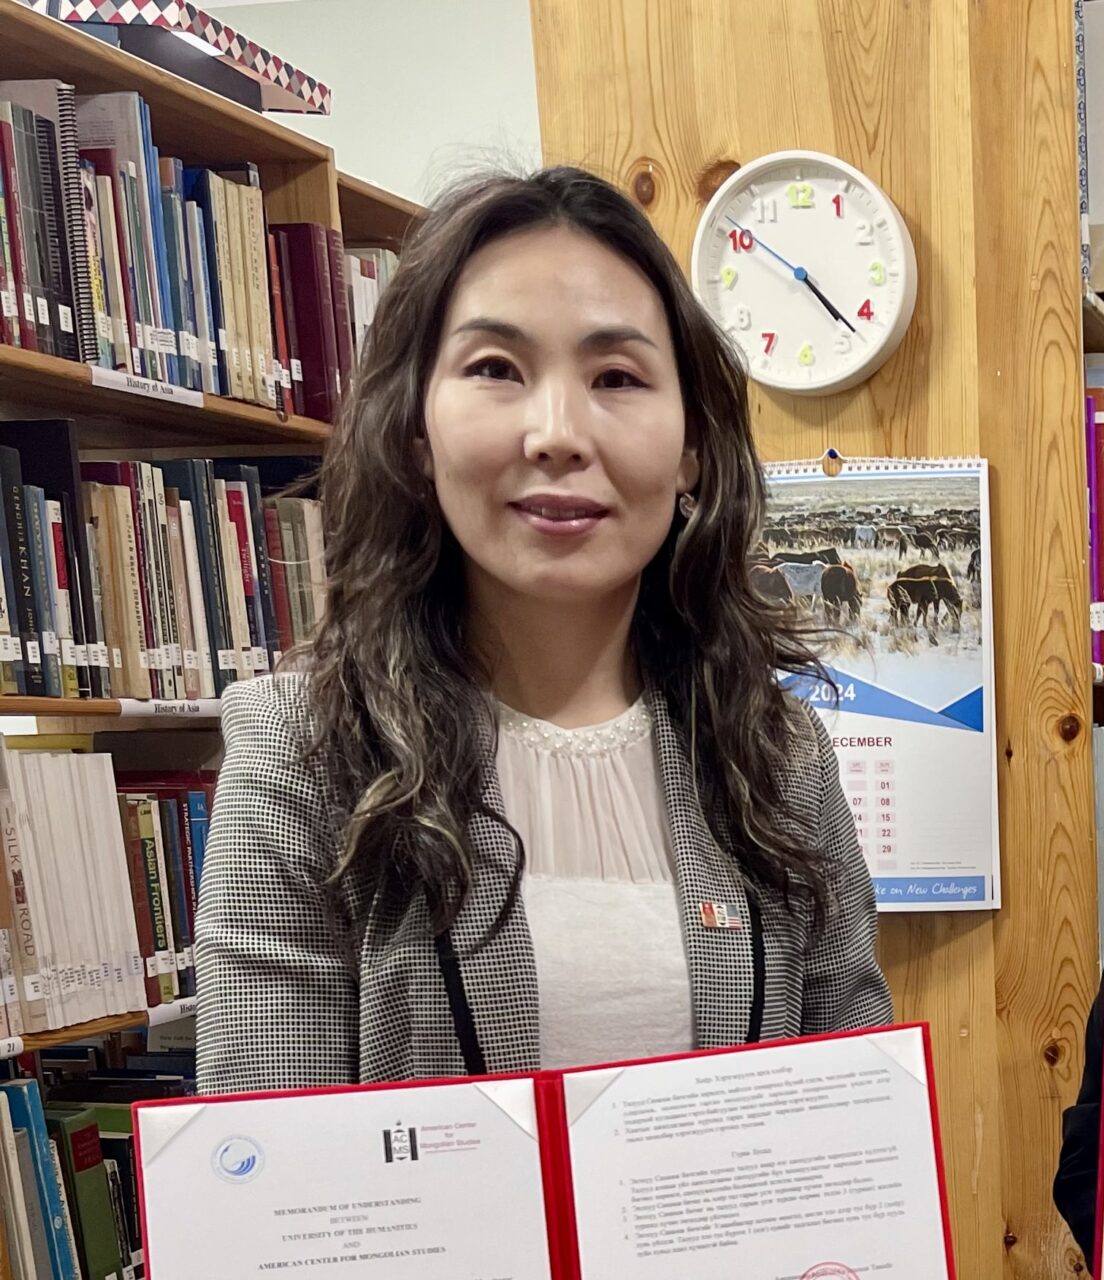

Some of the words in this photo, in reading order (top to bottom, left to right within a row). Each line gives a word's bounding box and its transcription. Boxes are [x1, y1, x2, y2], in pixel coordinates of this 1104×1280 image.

[787, 182, 814, 208] 12
[753, 199, 777, 223] 11
[832, 194, 843, 218] 1
[728, 229, 754, 253] 10
[857, 222, 874, 245] 2
[721, 266, 738, 290] 9
[869, 261, 885, 286] 3
[737, 305, 752, 330] 8
[857, 299, 874, 320] 4
[762, 332, 777, 354] 7
[835, 332, 852, 354] 5
[798, 344, 815, 365] 6
[126, 377, 150, 392] History
[151, 383, 159, 392] of
[161, 385, 174, 395] Asia
[18, 546, 32, 597] KHAN
[809, 683, 856, 701] 2024
[154, 703, 177, 715] History
[179, 703, 185, 712] of
[187, 704, 200, 712] Asia
[832, 736, 893, 747] ECEMBER
[880, 781, 890, 789] 01
[852, 797, 862, 806] 07
[880, 797, 890, 806] 08
[183, 803, 192, 845] STRATEGIC
[881, 814, 890, 822] 15
[882, 829, 891, 837] 22
[882, 845, 891, 853] 29
[5, 827, 22, 864] SILK
[19, 908, 35, 957] ROAD
[144, 839, 157, 880] Asian
[151, 882, 167, 949] Frontiers
[890, 887, 903, 896] on
[907, 884, 928, 895] New
[932, 883, 977, 899] Challenges
[392, 1134, 408, 1143] AC
[274, 1205, 336, 1215] MEMORANDUM
[351, 1197, 421, 1208] UNDERSTANDING
[329, 1214, 368, 1223] BETWEEN
[282, 1231, 331, 1241] UNIVERSITY
[347, 1227, 363, 1235] THE
[365, 1223, 417, 1233] HUMANITIES
[258, 1260, 302, 1270] AMERICAN
[304, 1256, 338, 1265] CENTER
[339, 1254, 356, 1262] FOR
[358, 1250, 409, 1260] MONGOLIAN
[411, 1246, 445, 1255] STUDIES
